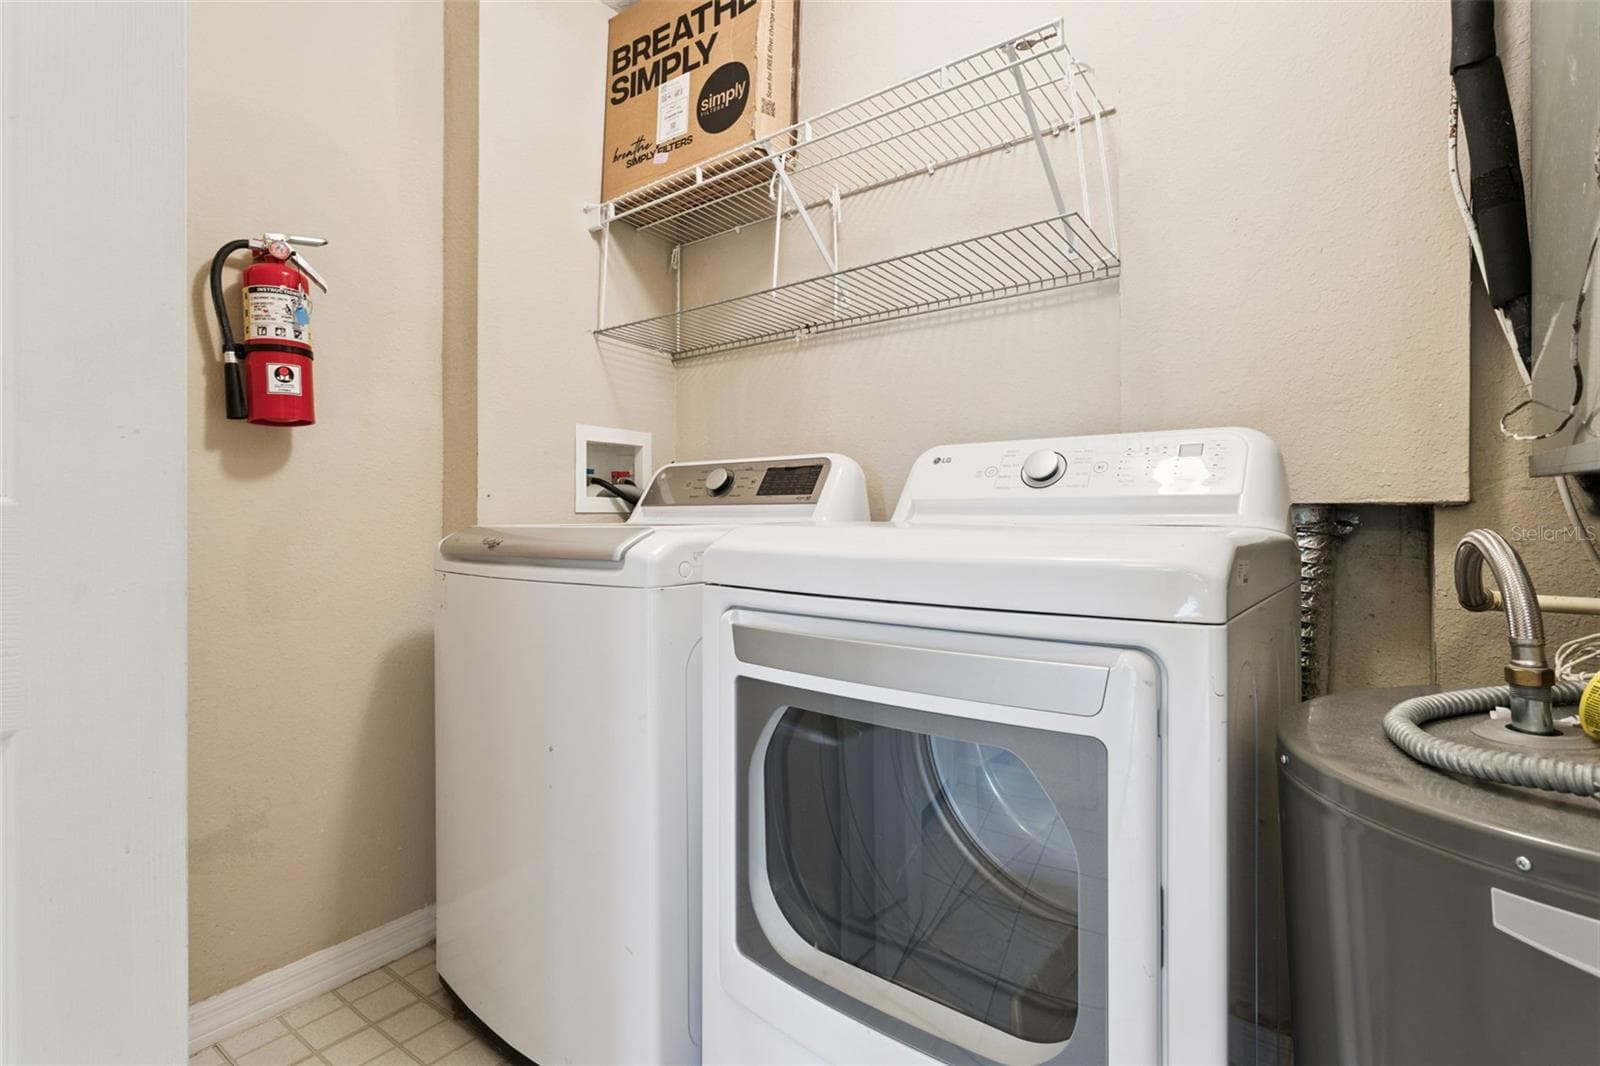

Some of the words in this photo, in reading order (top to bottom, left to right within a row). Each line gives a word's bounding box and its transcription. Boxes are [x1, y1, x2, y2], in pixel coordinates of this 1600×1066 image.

[610, 32, 719, 106] SIMPLY
[700, 80, 747, 112] simply
[625, 148, 656, 169] SIMPLY
[656, 134, 694, 154] FILTERS
[941, 456, 952, 464] LG
